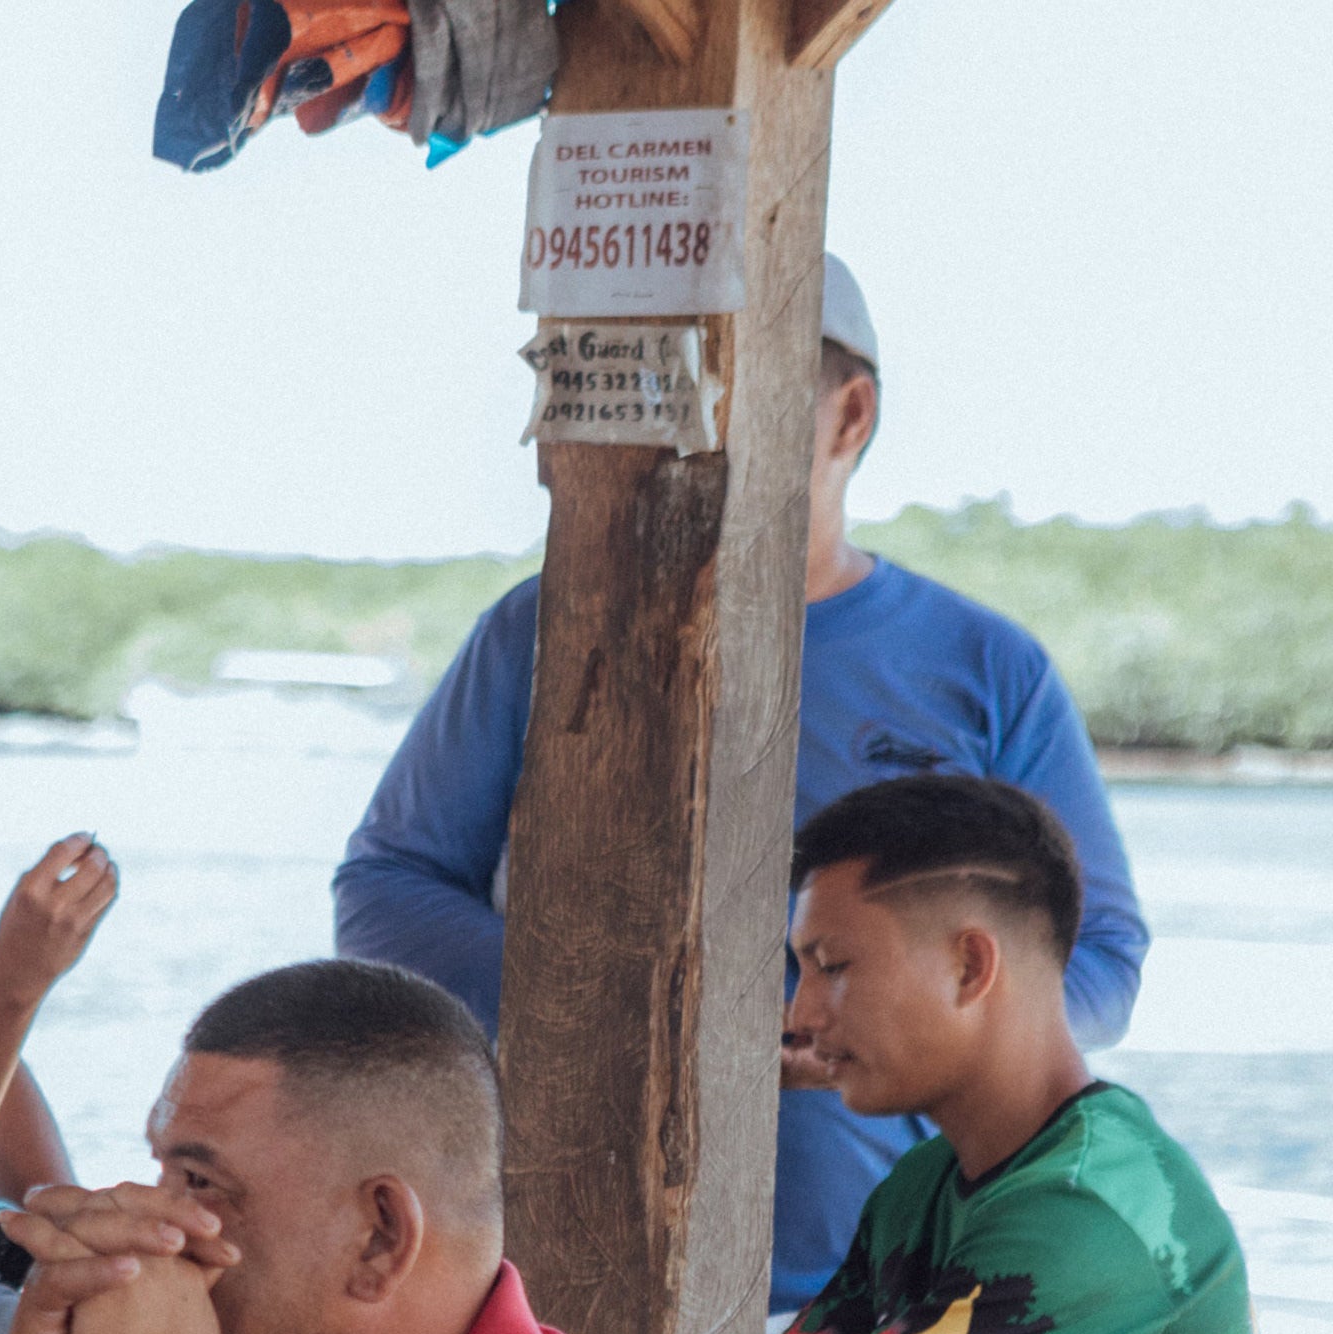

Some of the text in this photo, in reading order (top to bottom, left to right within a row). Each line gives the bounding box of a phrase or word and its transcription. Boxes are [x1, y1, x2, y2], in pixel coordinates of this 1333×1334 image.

[556, 139, 713, 162] DEL CARMEN
[577, 166, 690, 185] TOURISM
[574, 191, 689, 210] HOTLINE:
